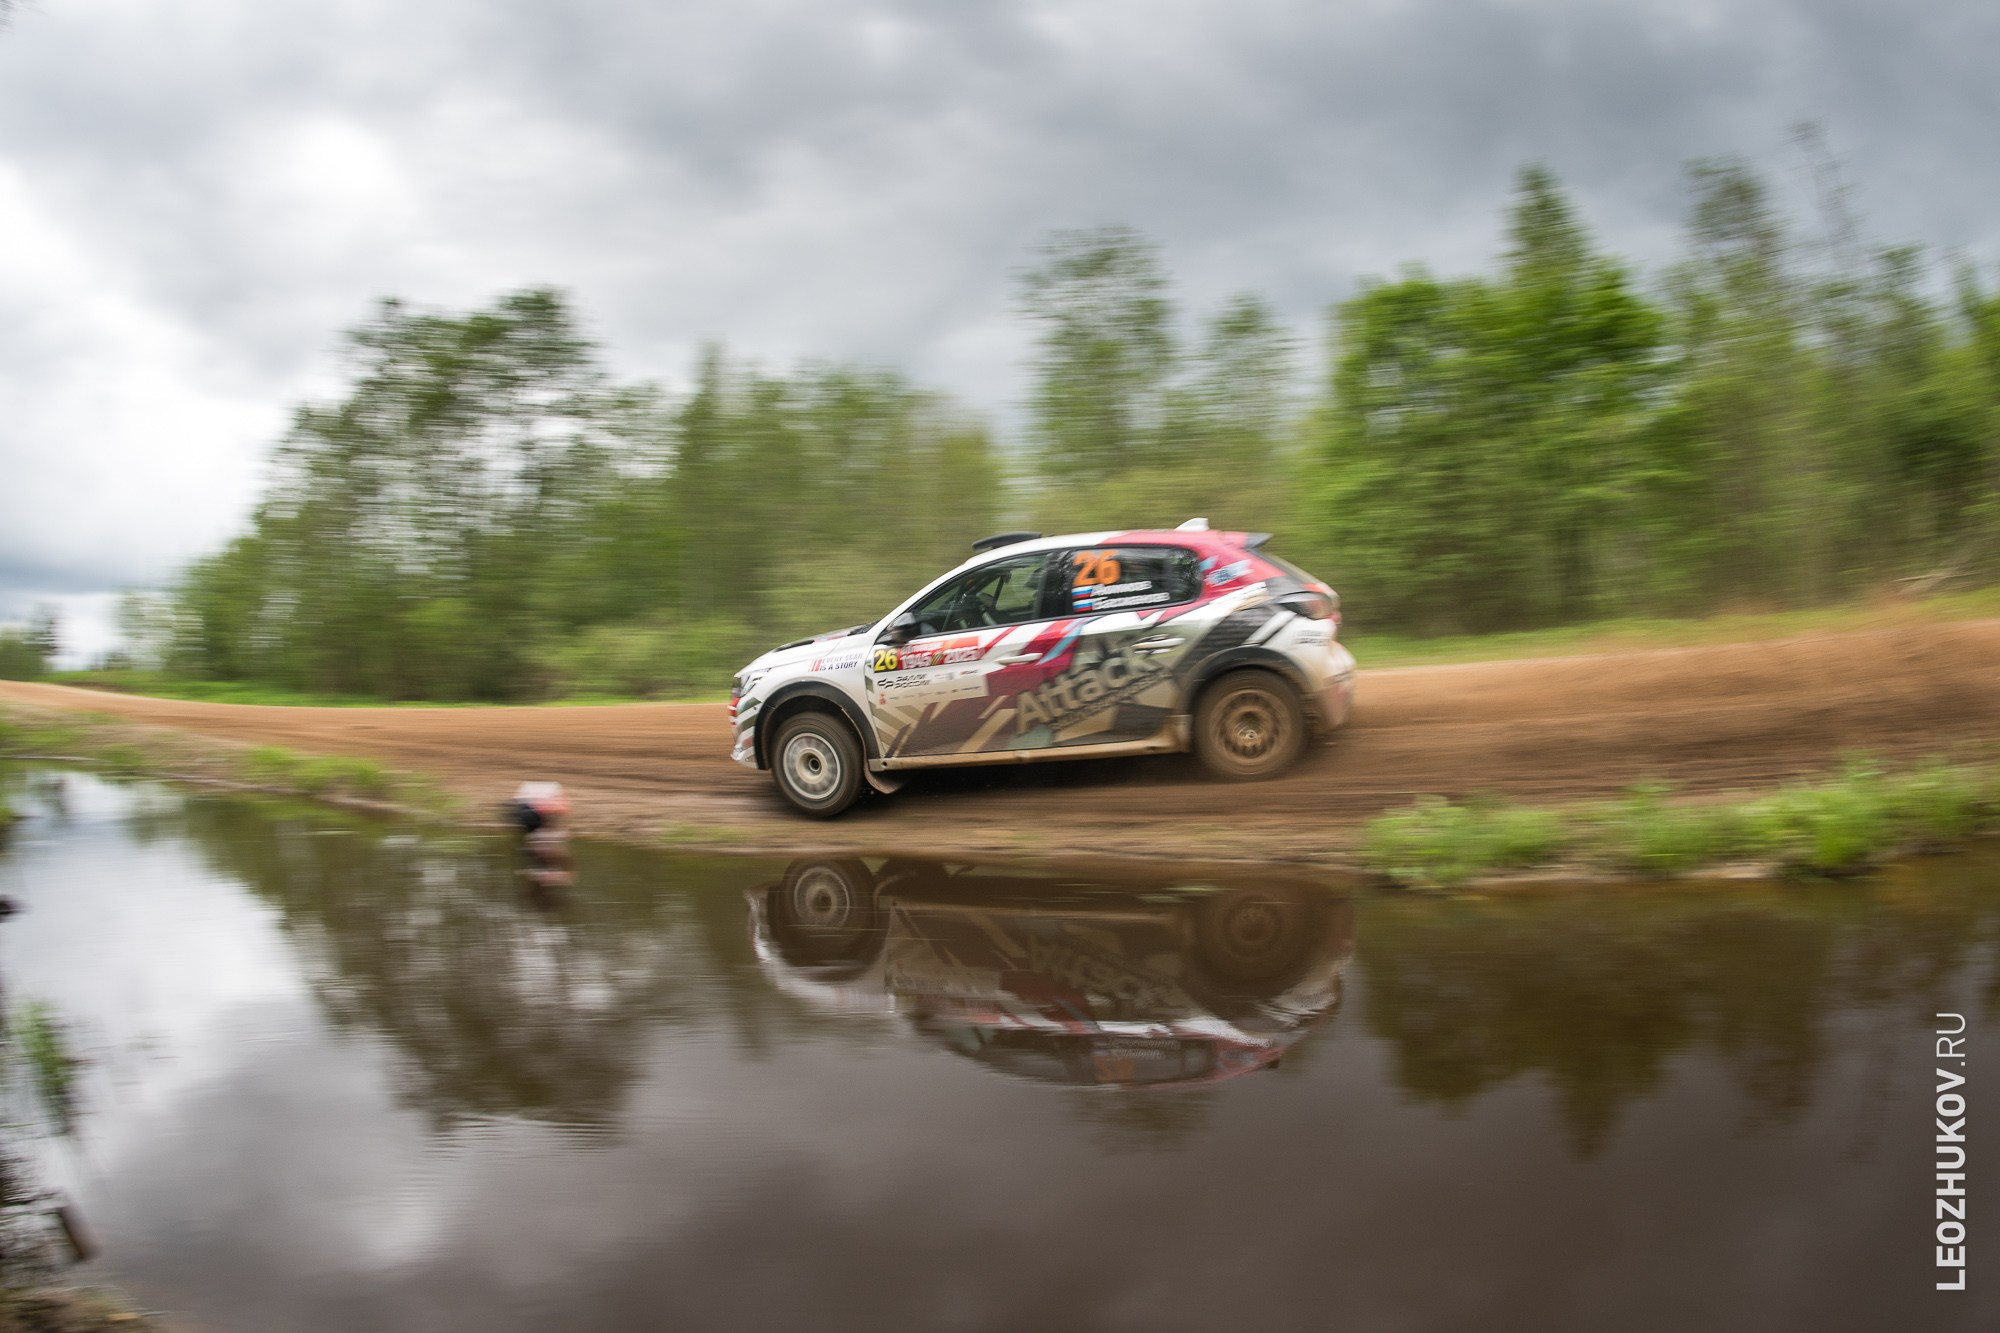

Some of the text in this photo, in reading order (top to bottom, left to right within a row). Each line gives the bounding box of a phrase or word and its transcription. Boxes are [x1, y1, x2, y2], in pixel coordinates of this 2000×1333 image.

[1072, 549, 1121, 587] 26
[836, 661, 858, 670] STORY
[874, 648, 898, 672] 26
[1014, 648, 1165, 736] Attack
